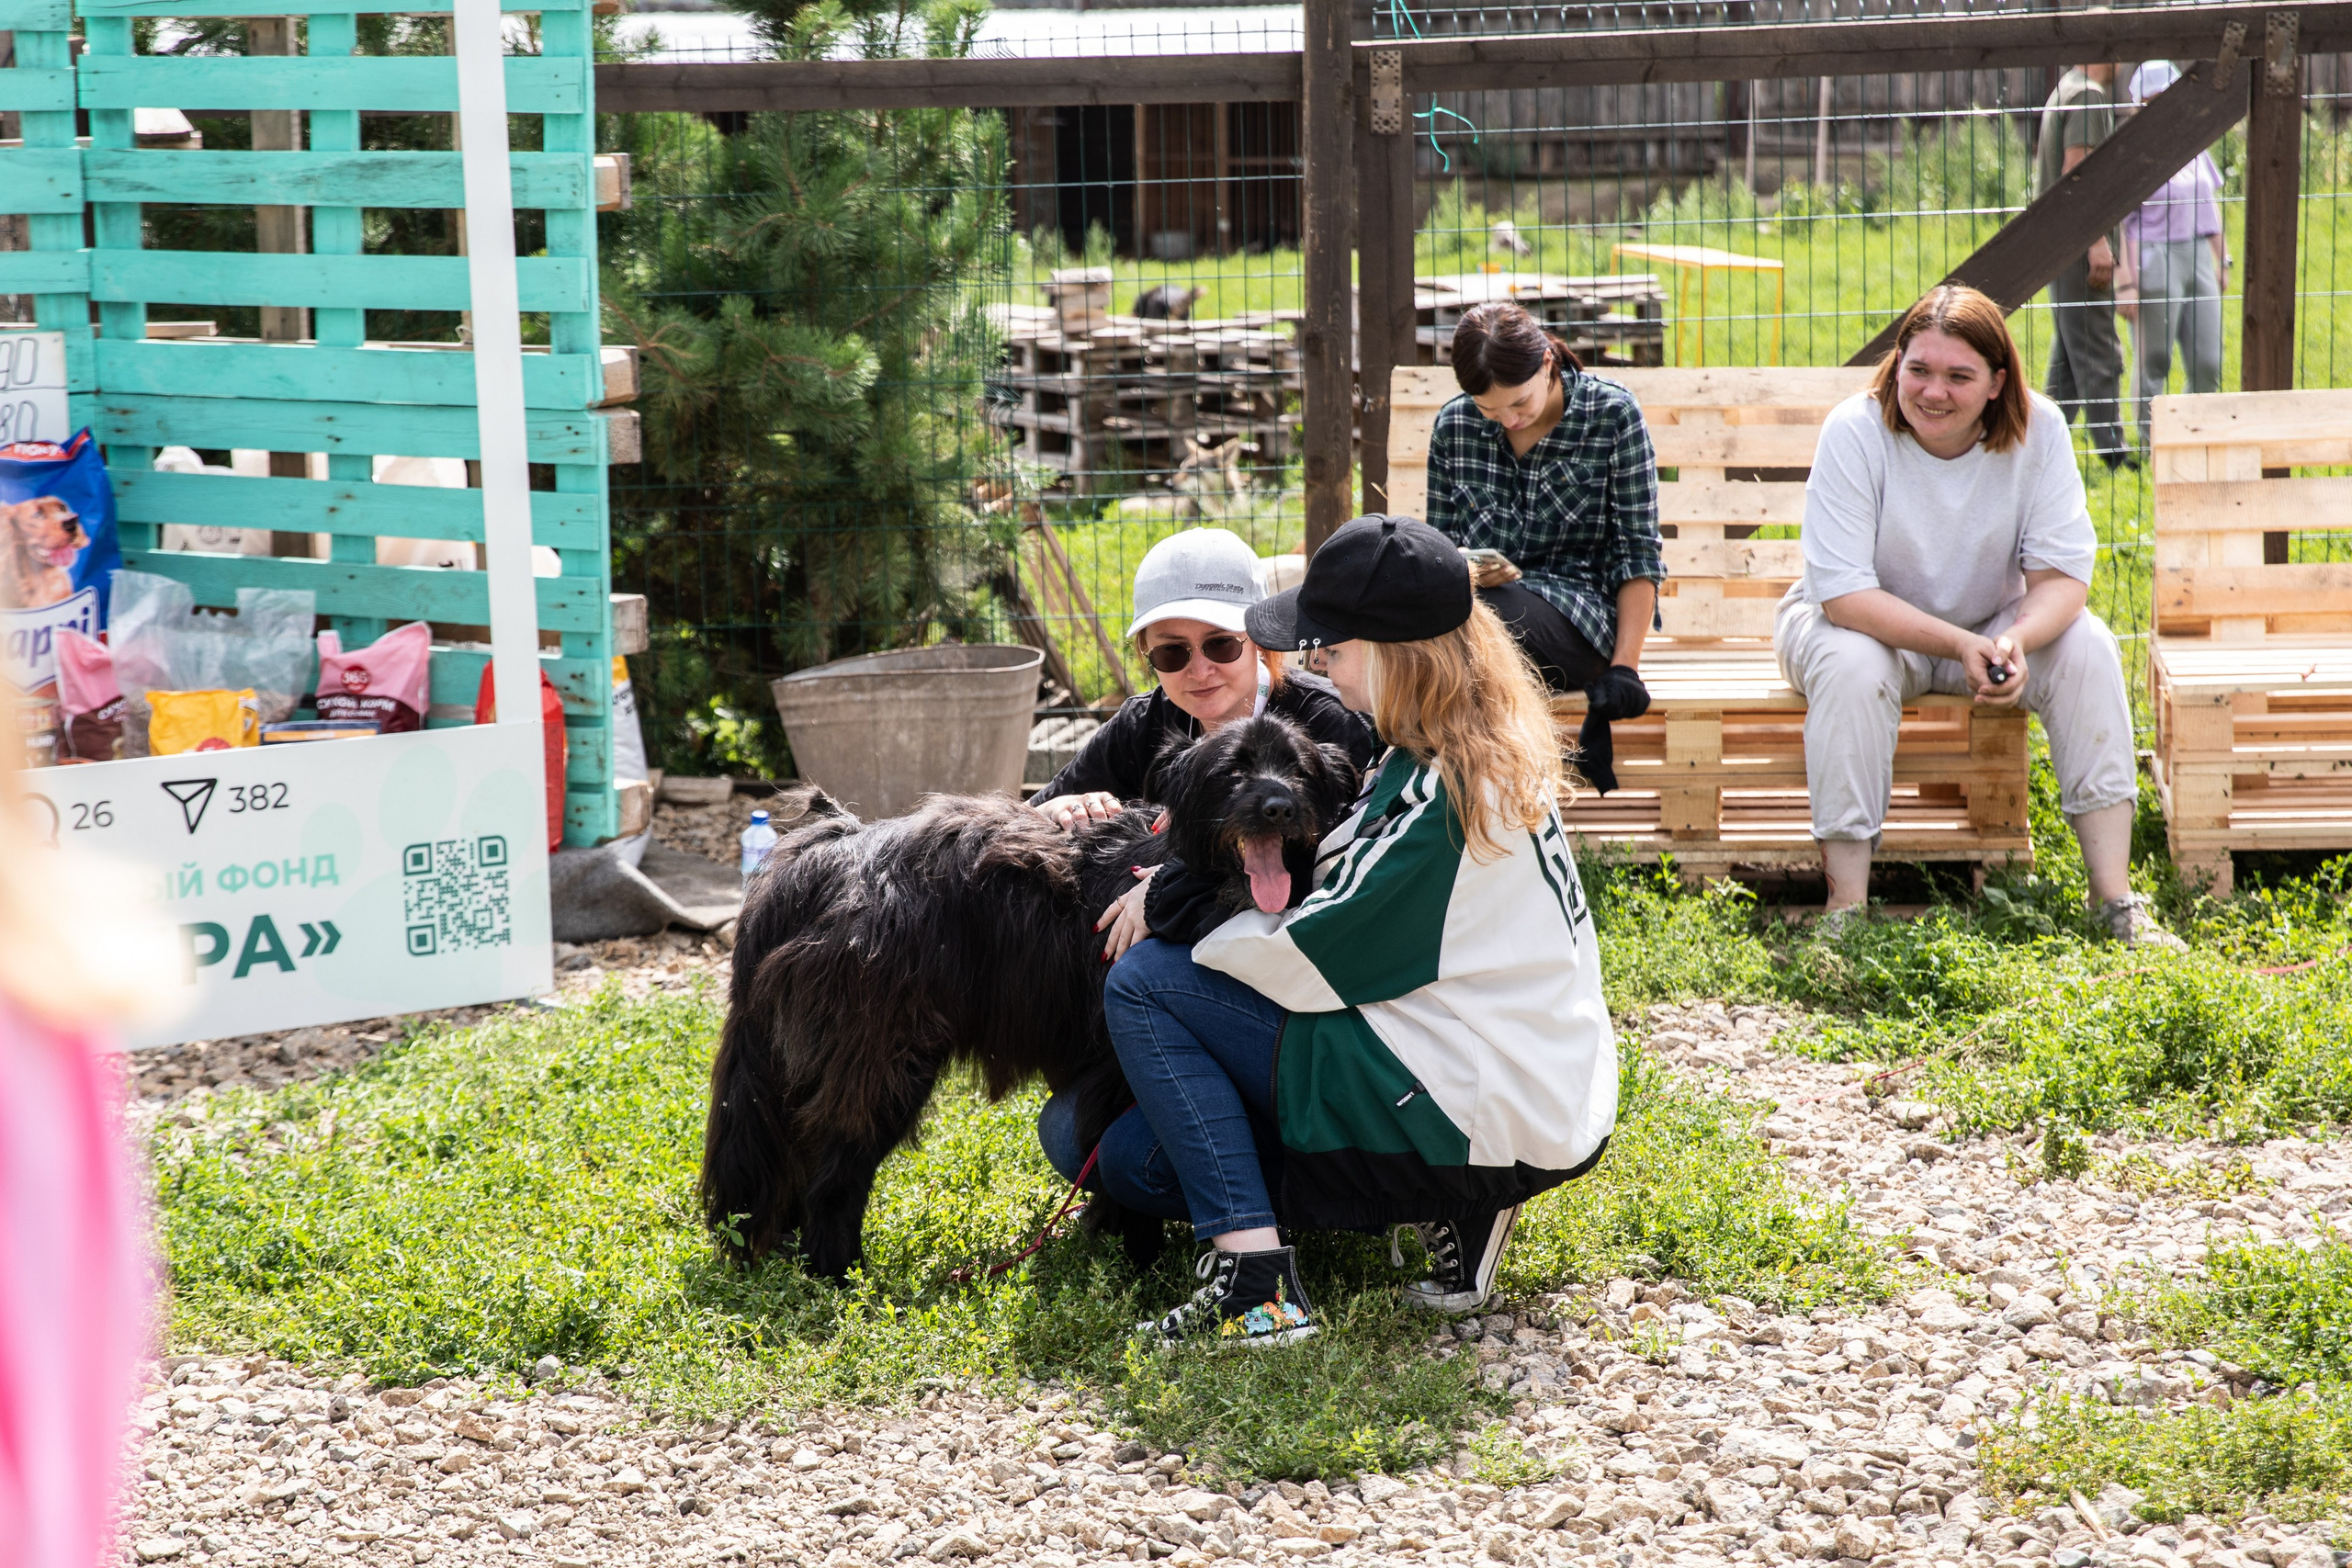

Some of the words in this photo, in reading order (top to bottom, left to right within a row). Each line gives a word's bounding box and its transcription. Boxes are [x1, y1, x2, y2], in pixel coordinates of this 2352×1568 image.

[1194, 581, 1226, 592] Dynamic
[1227, 582, 1245, 592] State
[341, 671, 369, 684] 365
[316, 695, 359, 710] СУХОЙ
[359, 698, 397, 713] КОРМ
[228, 782, 290, 814] 382
[71, 799, 114, 831] 26
[144, 861, 205, 904] ЫЙ
[216, 853, 341, 894] ФОНД
[178, 912, 343, 986] РА»
